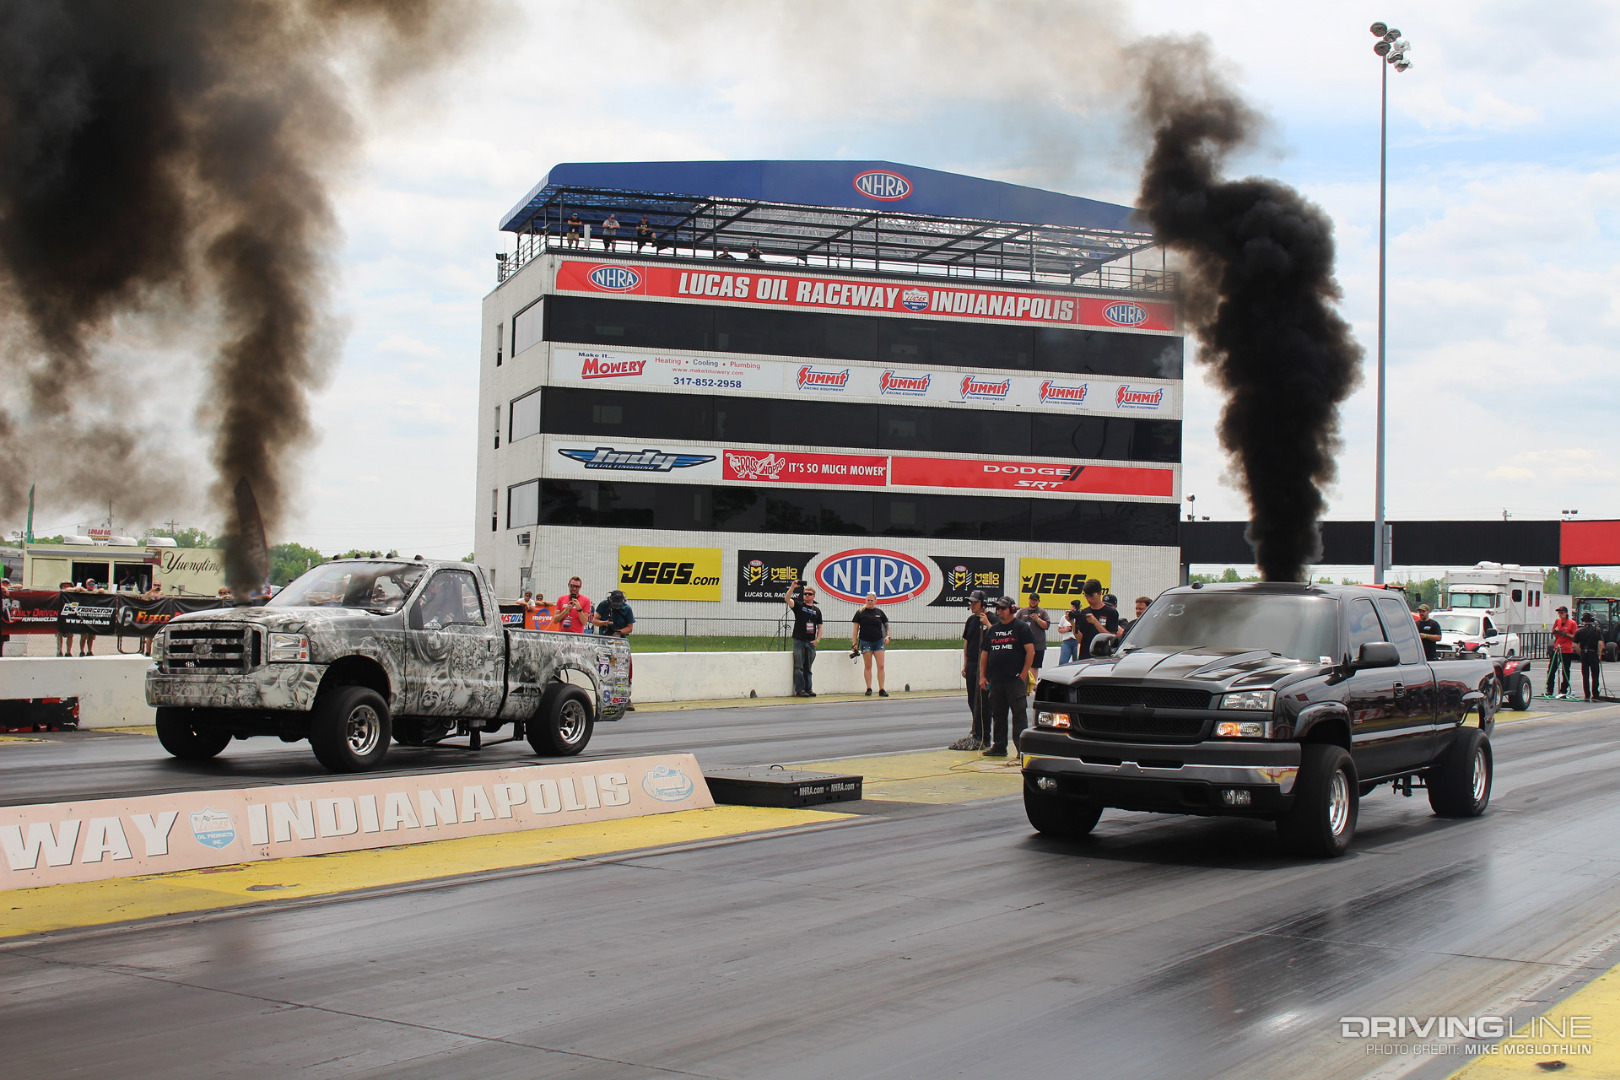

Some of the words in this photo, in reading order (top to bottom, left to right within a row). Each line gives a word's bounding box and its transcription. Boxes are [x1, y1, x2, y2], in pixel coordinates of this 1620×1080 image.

[861, 173, 905, 198] NHRA
[591, 267, 638, 289] NHRA
[678, 272, 751, 299] LUCAS
[756, 278, 789, 302] OIL
[795, 281, 900, 310] RACEWAY
[931, 290, 1075, 322] INDIANAPOLIS
[1107, 304, 1144, 325] NHRA
[582, 357, 647, 376] MOWERY
[655, 357, 682, 366] Heating
[693, 358, 719, 368] Cooling
[729, 361, 761, 371] Plumbing
[673, 376, 742, 389] 317-852-2958
[591, 449, 679, 470] Indy
[788, 462, 805, 473] IT'S
[807, 463, 819, 474] SO
[821, 463, 847, 475] MUCH
[983, 464, 1072, 476] DODGE
[1014, 480, 1063, 490] SRT
[161, 550, 223, 576] Yuengling
[621, 561, 720, 586] JEGS.com
[833, 556, 914, 597] NHRA
[11, 609, 32, 617] DAILY
[32, 609, 59, 617] DRIVEN
[136, 611, 171, 624] FLEECE
[800, 786, 825, 796] NHRA.com
[830, 782, 855, 793] NHRA.com
[247, 772, 631, 846] INDIANAPOLIS
[0, 810, 180, 872] WAY
